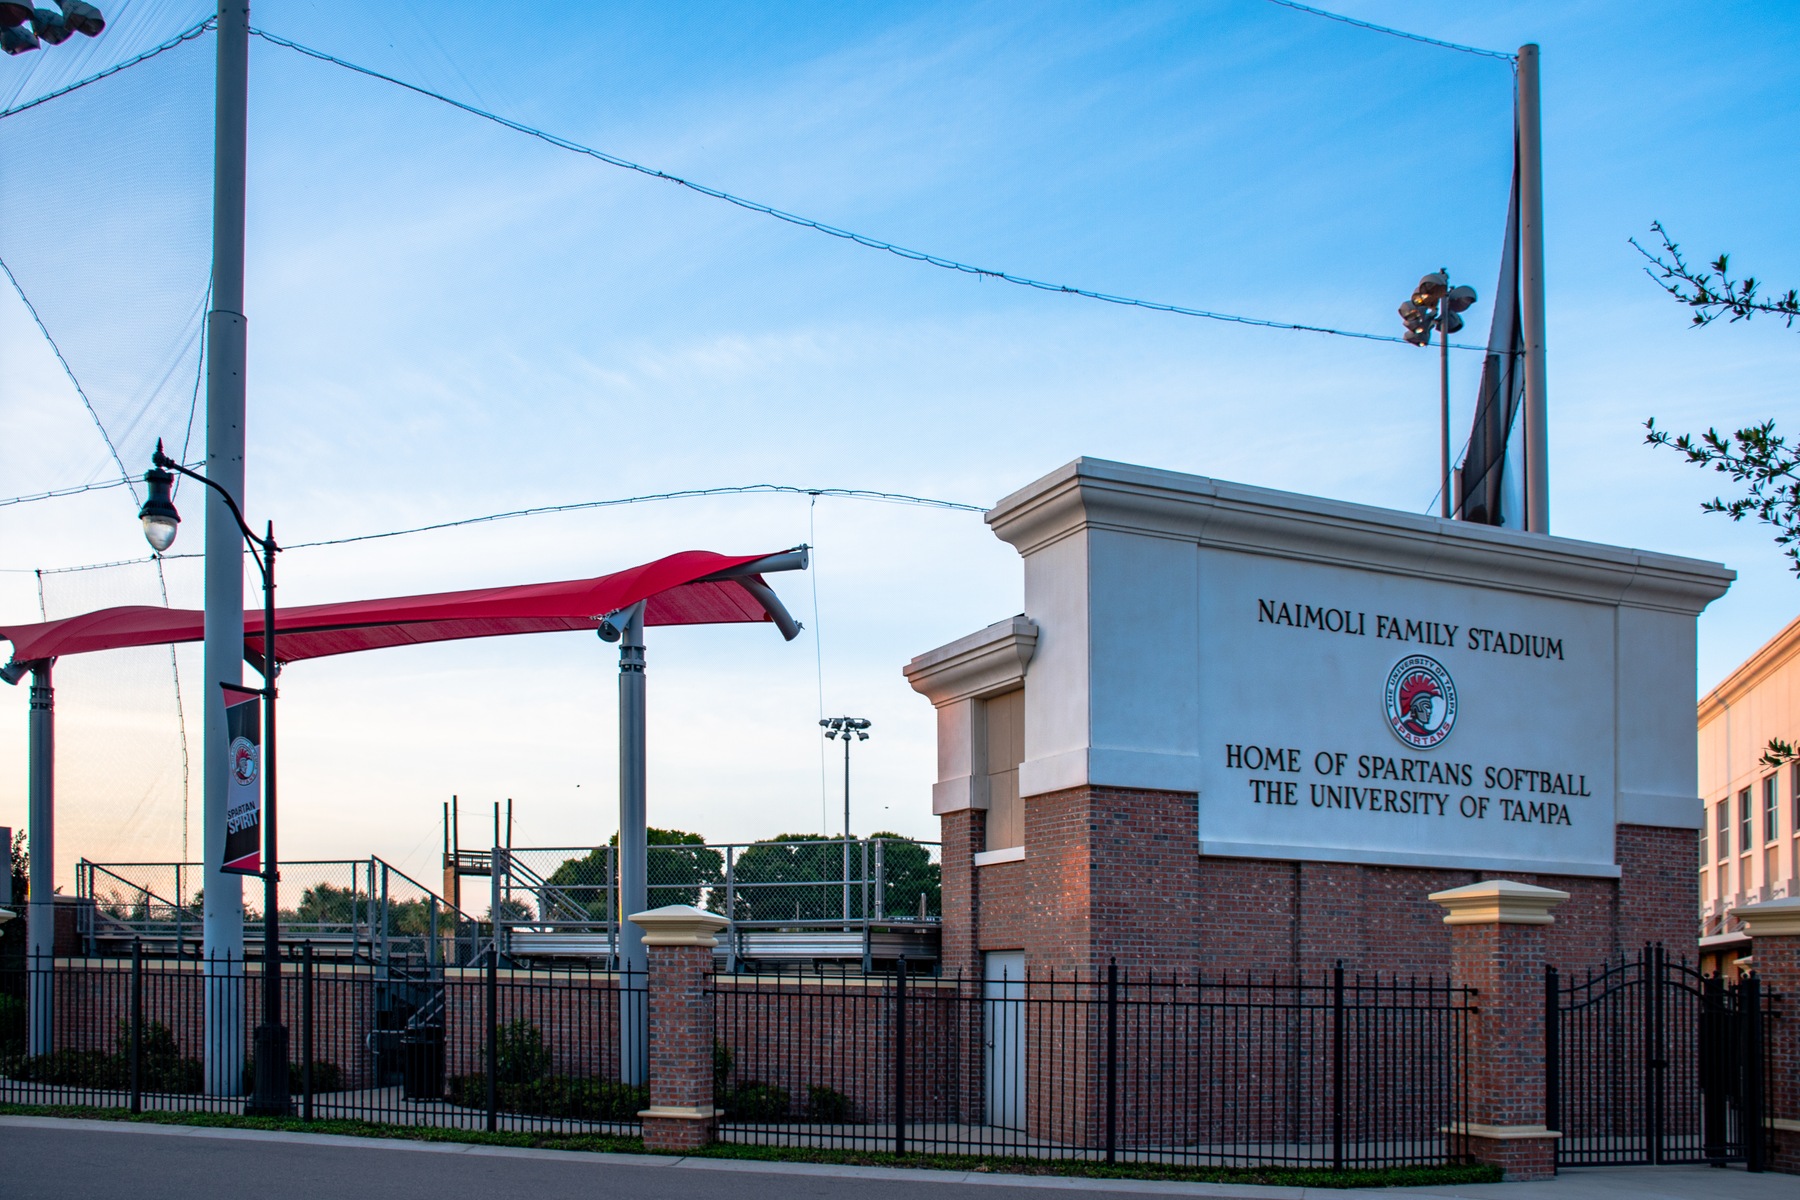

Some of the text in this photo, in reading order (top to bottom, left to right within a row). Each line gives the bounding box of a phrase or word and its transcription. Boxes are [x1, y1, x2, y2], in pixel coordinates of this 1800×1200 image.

[1258, 598, 1565, 661] NAIMOLI FAMILY STADIUM
[1390, 658, 1434, 686] UNIVERSITY
[1435, 667, 1446, 678] OF
[1444, 679, 1455, 715] TAMPA
[1391, 716, 1451, 745] SPARTANS
[1225, 744, 1591, 797] HOME OF SPARTANS SOFTBALL
[228, 801, 256, 820] SPARTAN
[229, 811, 258, 834] SPIRIT
[1249, 779, 1572, 826] THE UNIVERSITY OF TAMPA
